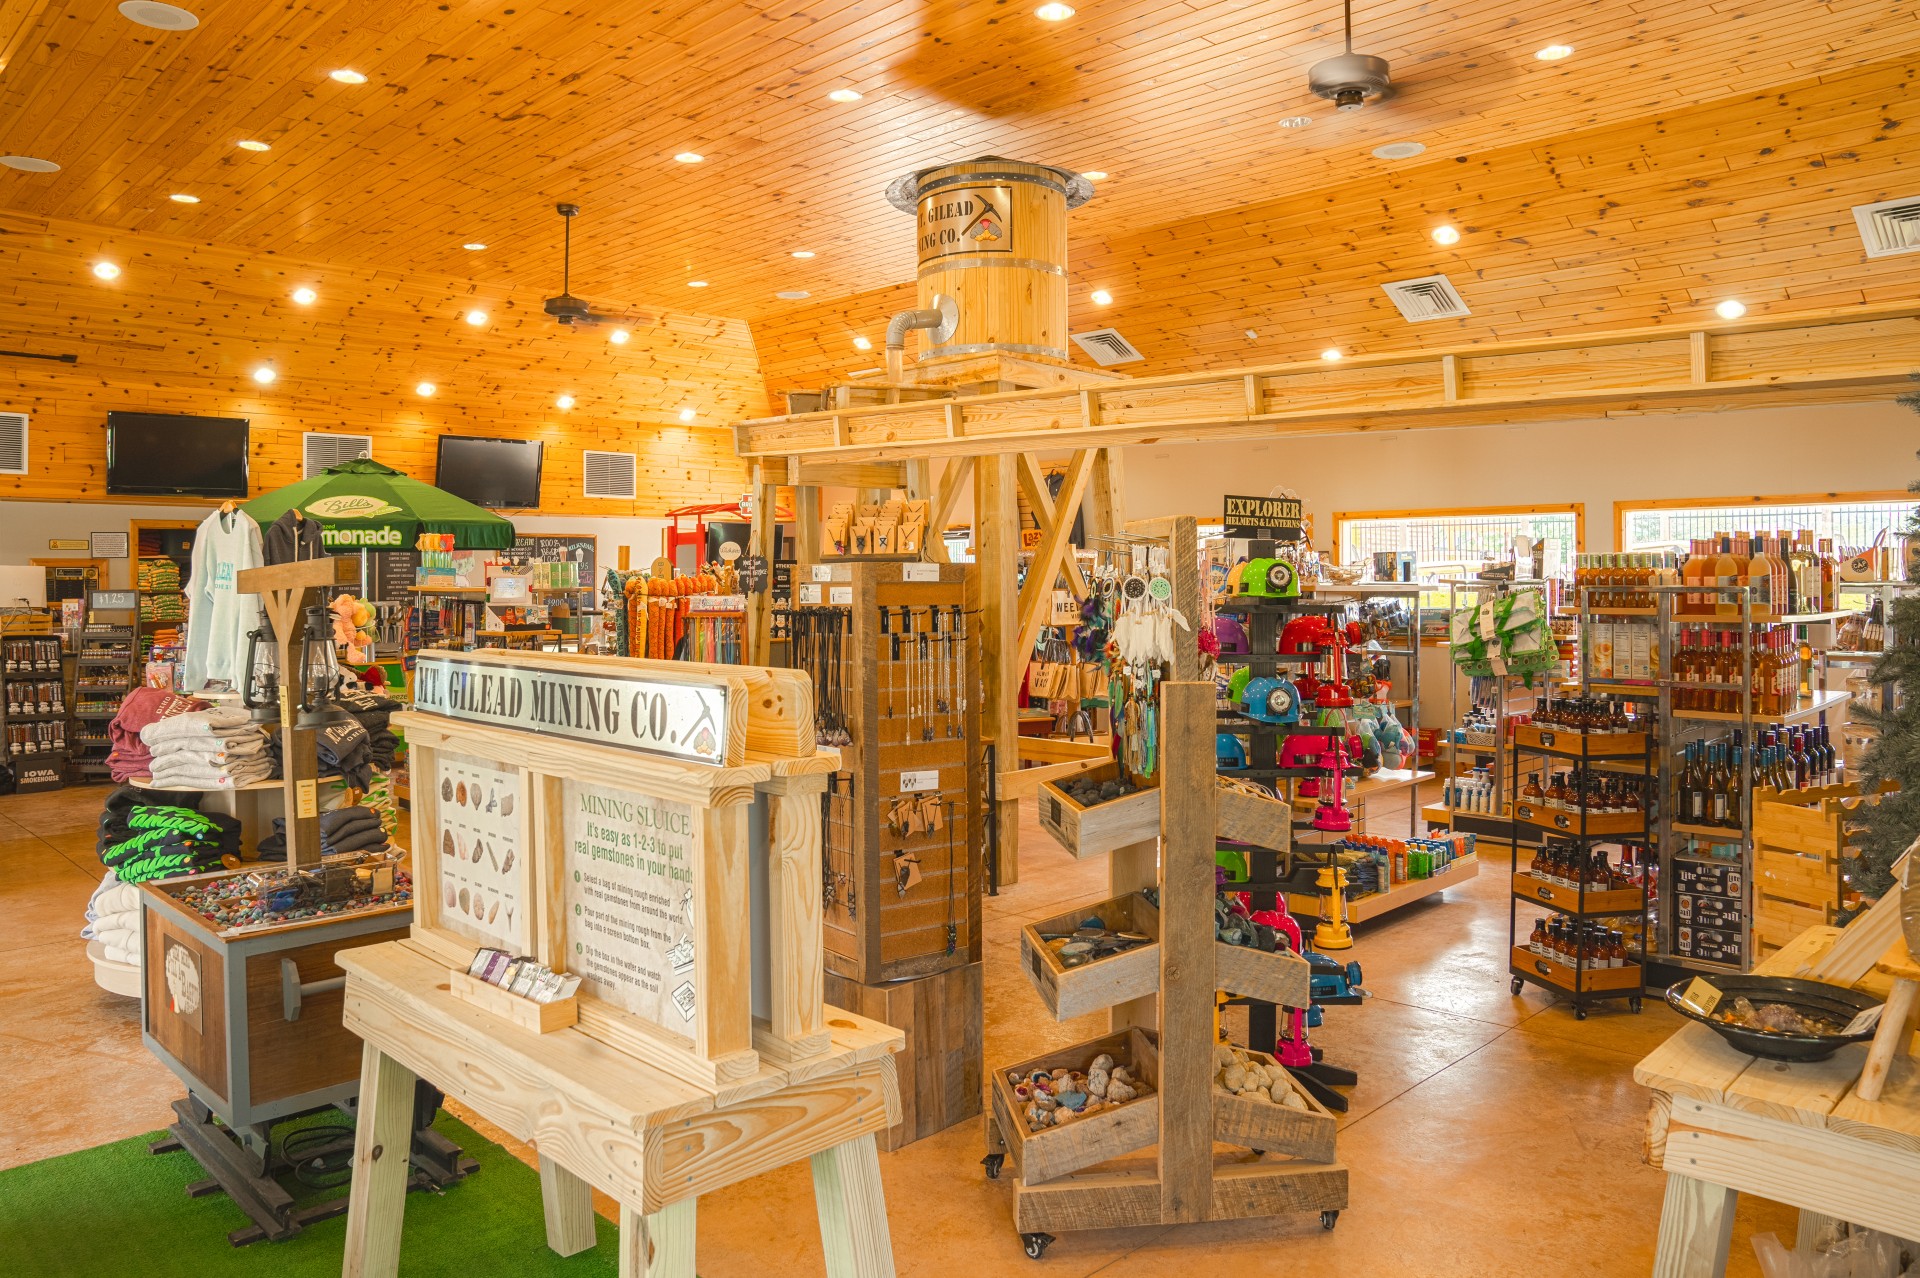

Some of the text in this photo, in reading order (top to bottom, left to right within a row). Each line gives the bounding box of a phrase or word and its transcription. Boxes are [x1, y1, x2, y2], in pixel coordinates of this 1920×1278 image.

[928, 200, 974, 223] GILEAD
[940, 228, 960, 245] CO.
[324, 498, 374, 514] Bill's
[1226, 498, 1300, 518] EXPLORER
[1226, 516, 1300, 528] HELMETS & LANTERNS
[100, 593, 124, 605] $1.25
[418, 666, 677, 744] MT. GILEAD MINING CO.
[20, 775, 59, 784] SMOKEHOUSE
[24, 769, 55, 778] IOWA
[580, 793, 690, 836] MINING SLUICE
[587, 821, 683, 861] It's easy as 1-2-3 to put
[574, 840, 589, 855] real
[591, 845, 635, 868] gemstones
[637, 853, 645, 871] in
[647, 859, 666, 877] your
[1680, 870, 1697, 881] Lite
[584, 873, 598, 885] Select
[602, 879, 611, 890] bag
[611, 882, 617, 890] of
[617, 884, 634, 898] mining
[634, 888, 648, 901] rough
[649, 892, 671, 907] enriched
[584, 887, 593, 895] with
[594, 889, 603, 898] real
[604, 893, 629, 907] gemstones
[629, 899, 641, 910] from
[641, 903, 661, 917] around
[669, 913, 684, 925] world.
[585, 906, 594, 917] Pour
[595, 910, 605, 922] part
[605, 912, 610, 922] of
[610, 914, 618, 925] the
[619, 919, 635, 932] mining
[636, 924, 650, 937] rough
[651, 929, 662, 940] from
[663, 932, 672, 943] the
[585, 919, 593, 930] bag
[594, 922, 602, 933] into
[607, 927, 622, 939] screen
[623, 931, 639, 945] bottom
[640, 938, 651, 949] box.
[594, 961, 617, 977] gemstones
[618, 971, 634, 984] appear
[634, 977, 641, 985] as
[649, 982, 659, 994] soil
[602, 951, 610, 961] box
[611, 955, 615, 964] in
[624, 960, 637, 972] water
[638, 964, 647, 976] and
[647, 967, 661, 981] watch
[586, 971, 616, 990] washes away.
